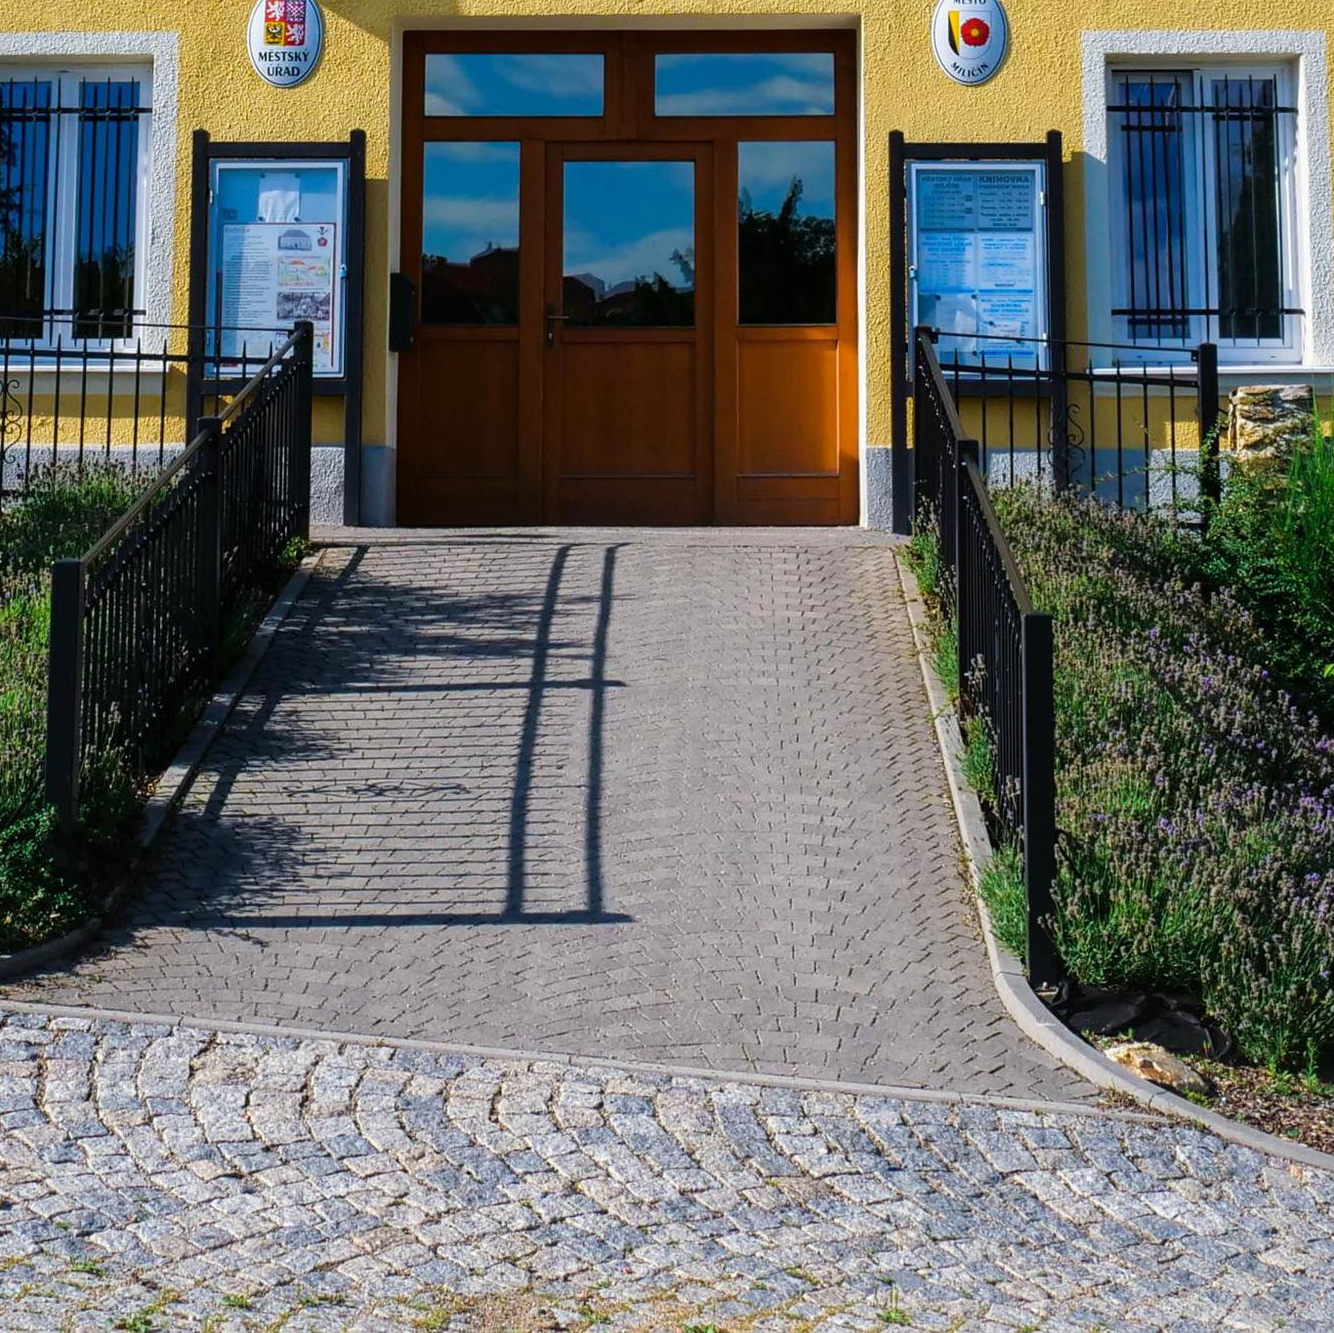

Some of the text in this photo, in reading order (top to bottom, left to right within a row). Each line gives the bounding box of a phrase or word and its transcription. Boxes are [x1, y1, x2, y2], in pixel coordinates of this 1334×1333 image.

[258, 49, 310, 62] MĚSTSKÝ
[267, 63, 300, 77] ÚŘAD
[951, 61, 989, 78] MILIČÍN
